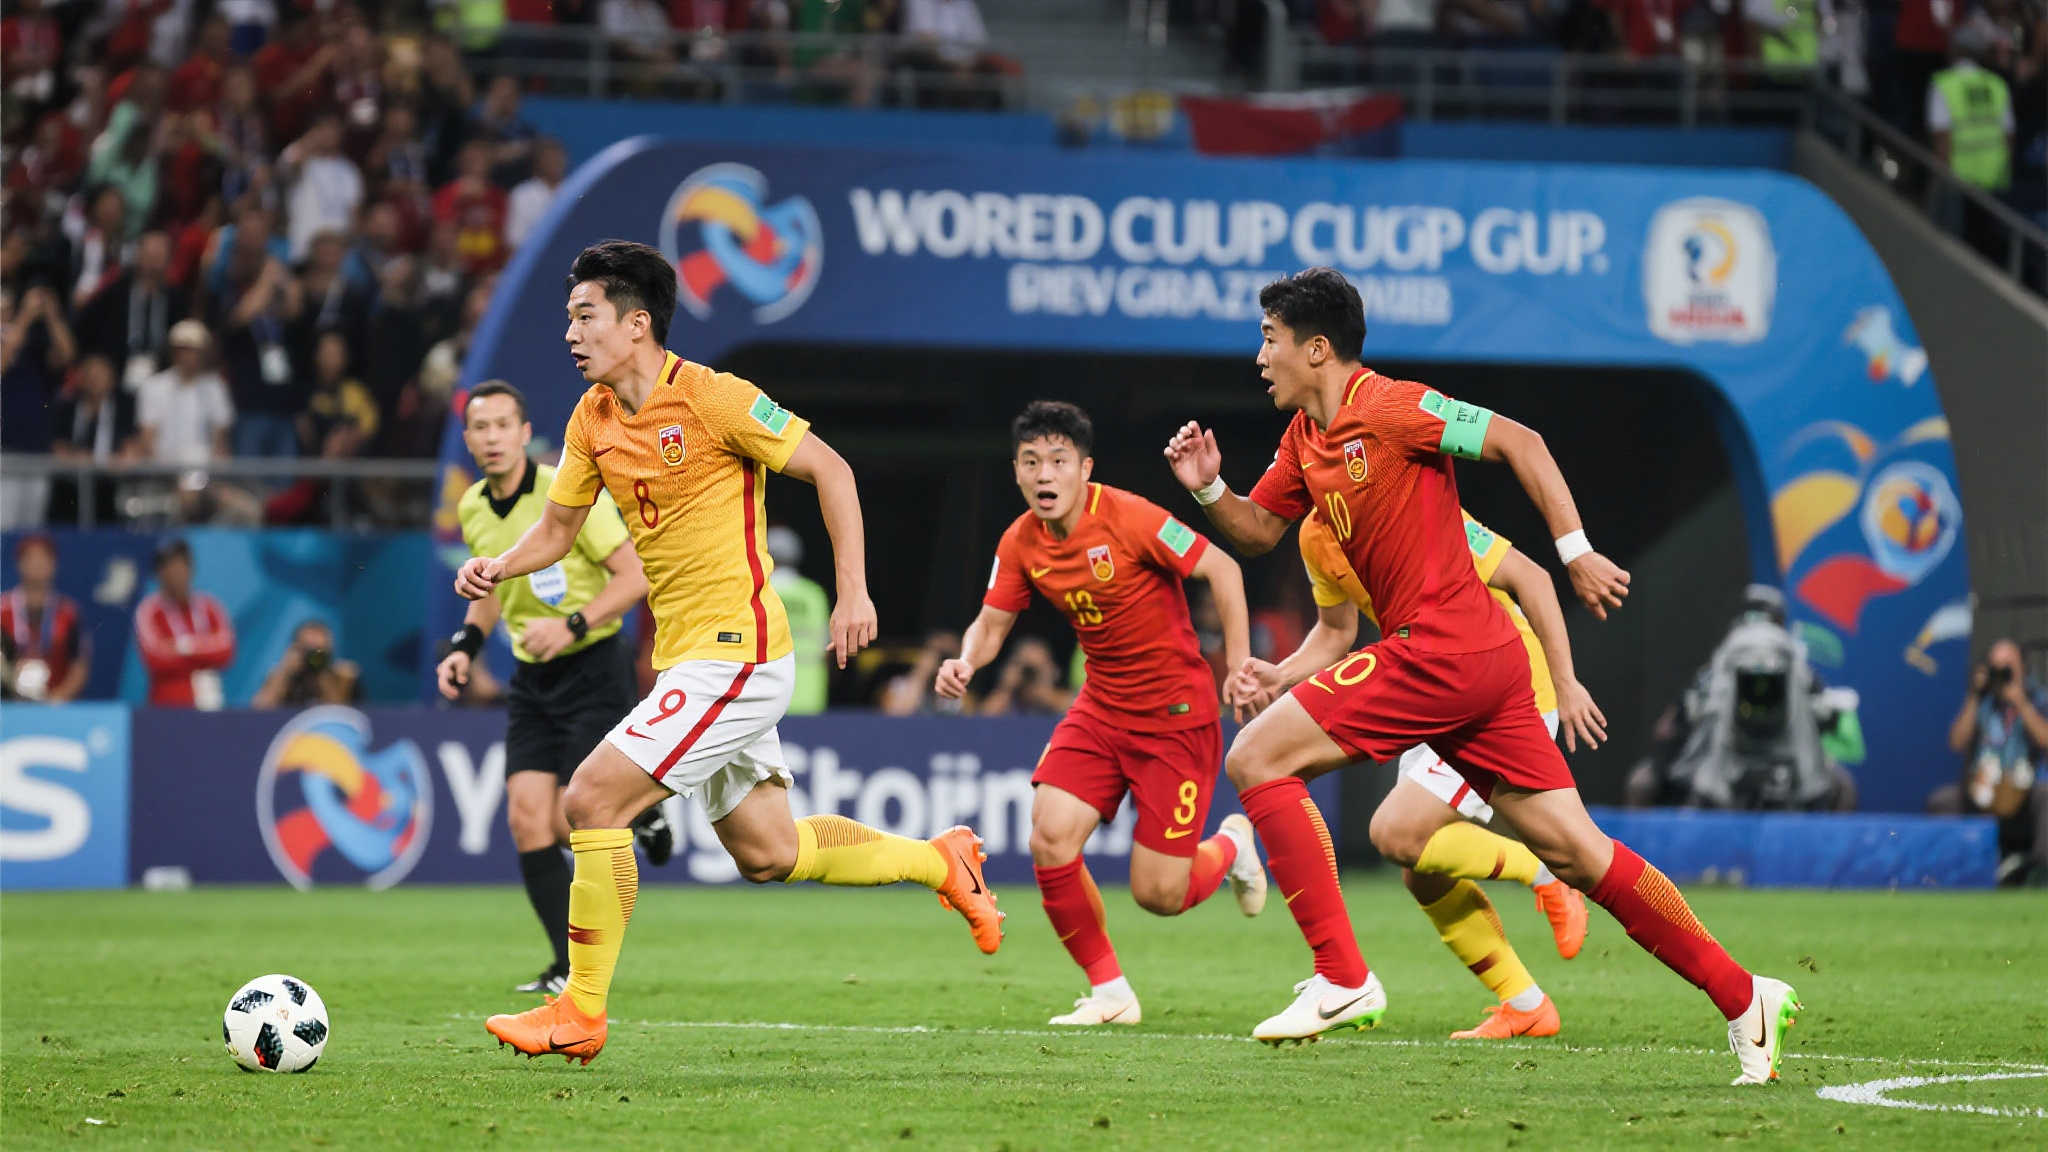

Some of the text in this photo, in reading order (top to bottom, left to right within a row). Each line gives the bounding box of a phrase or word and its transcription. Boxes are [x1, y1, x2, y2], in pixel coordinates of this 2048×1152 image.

[633, 479, 658, 529] 8
[1325, 491, 1351, 541] 10
[646, 688, 687, 726] 9
